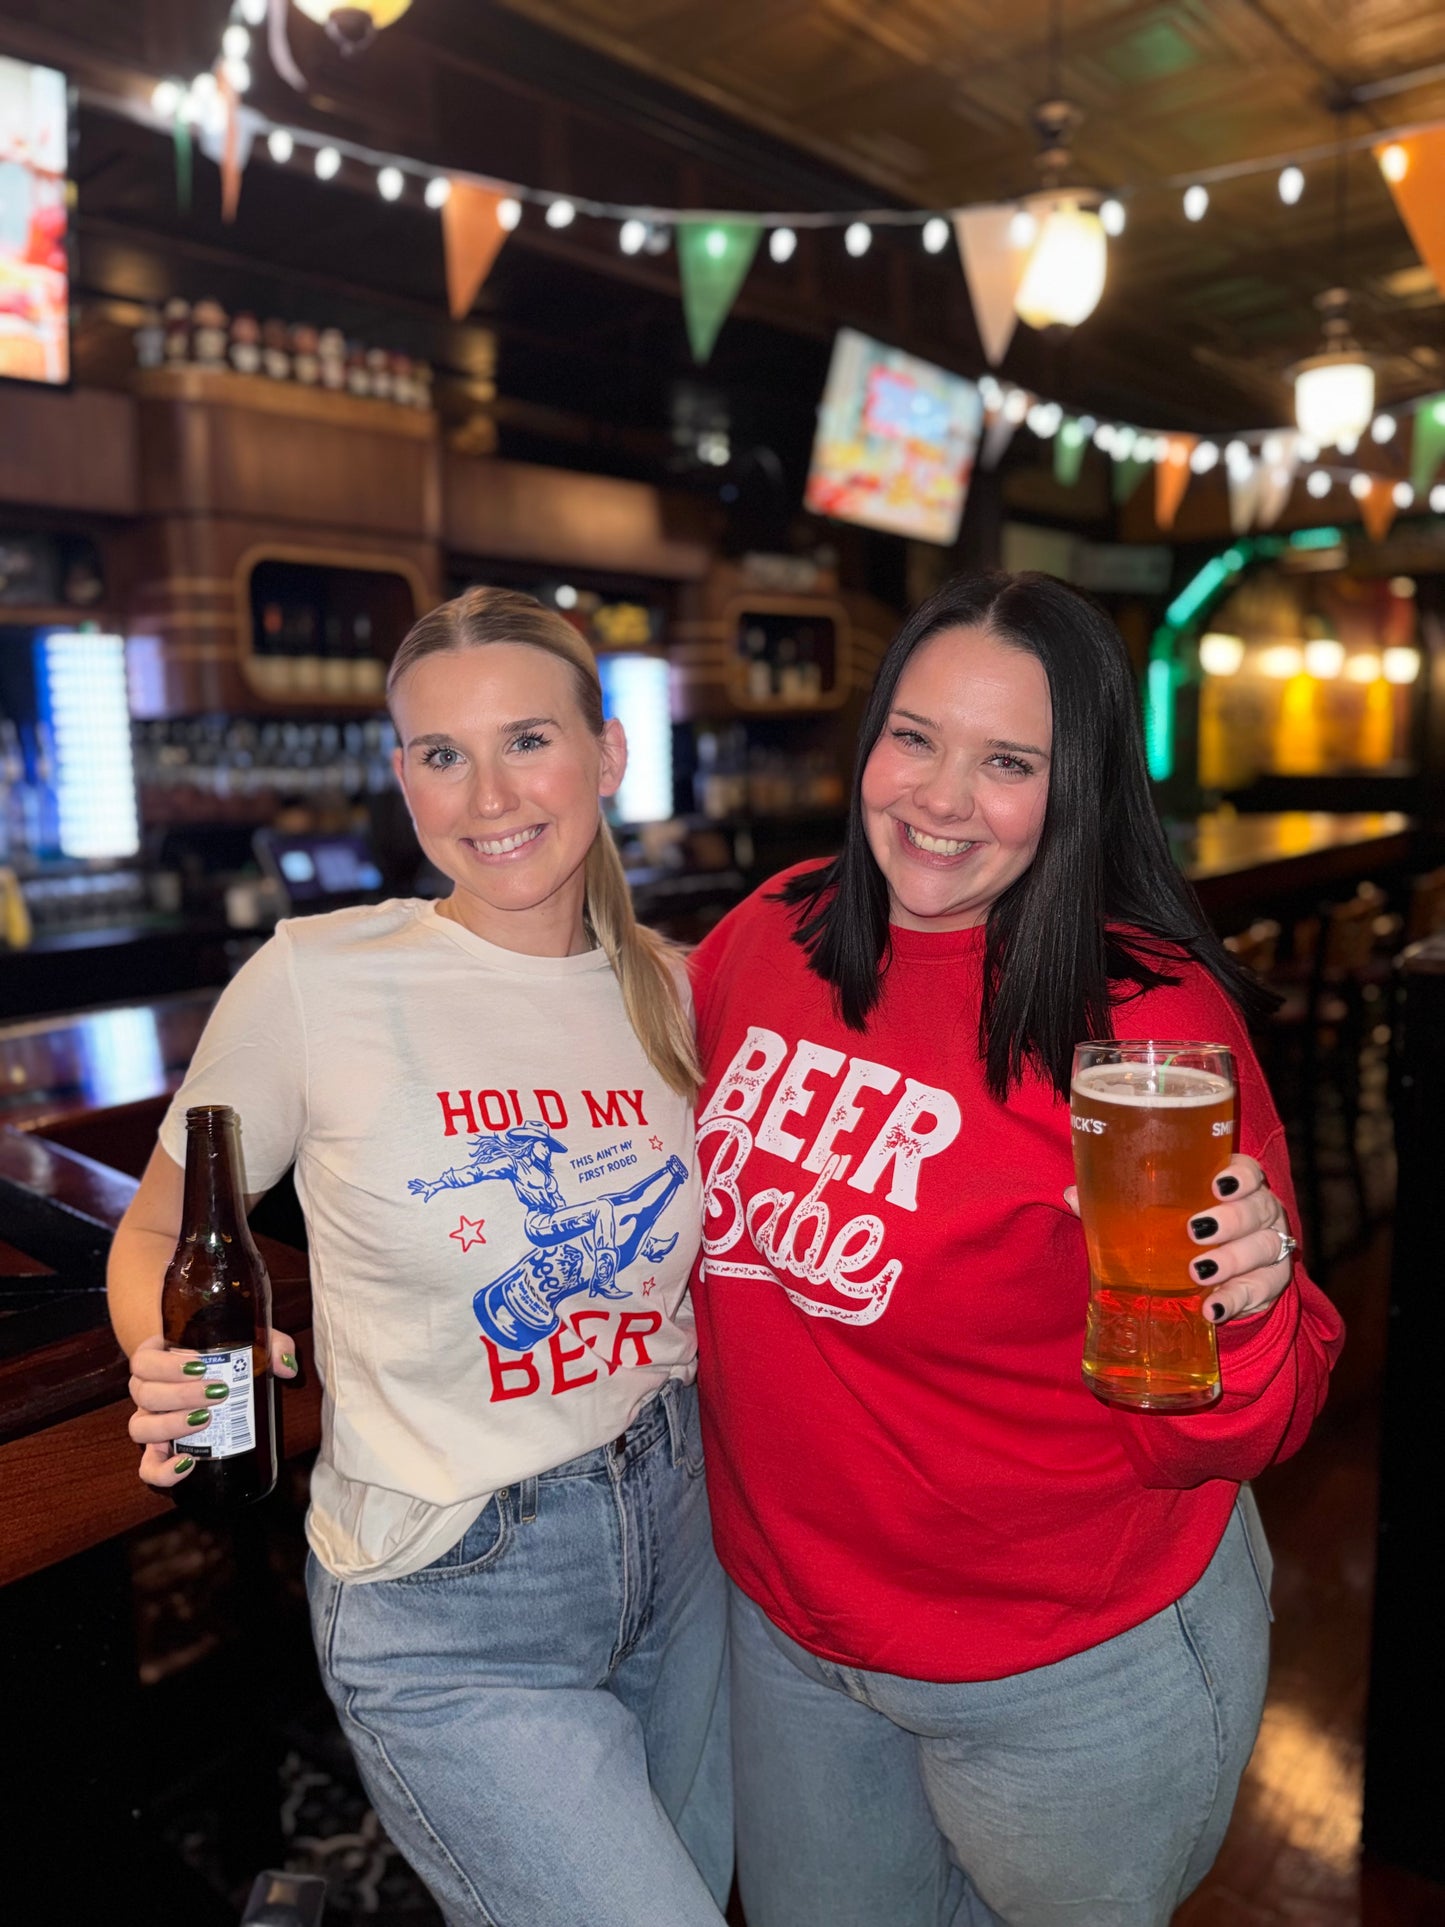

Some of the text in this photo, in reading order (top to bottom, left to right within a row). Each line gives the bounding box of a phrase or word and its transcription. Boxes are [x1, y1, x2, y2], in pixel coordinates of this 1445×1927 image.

[437, 1089, 649, 1136] HOLD MY
[698, 1026, 961, 1212] BEER
[569, 1140, 632, 1169] THIS AIN'T MY
[578, 1154, 638, 1183] FIRST RODEO
[696, 1116, 902, 1304] Babe
[480, 1311, 662, 1403] BEER
